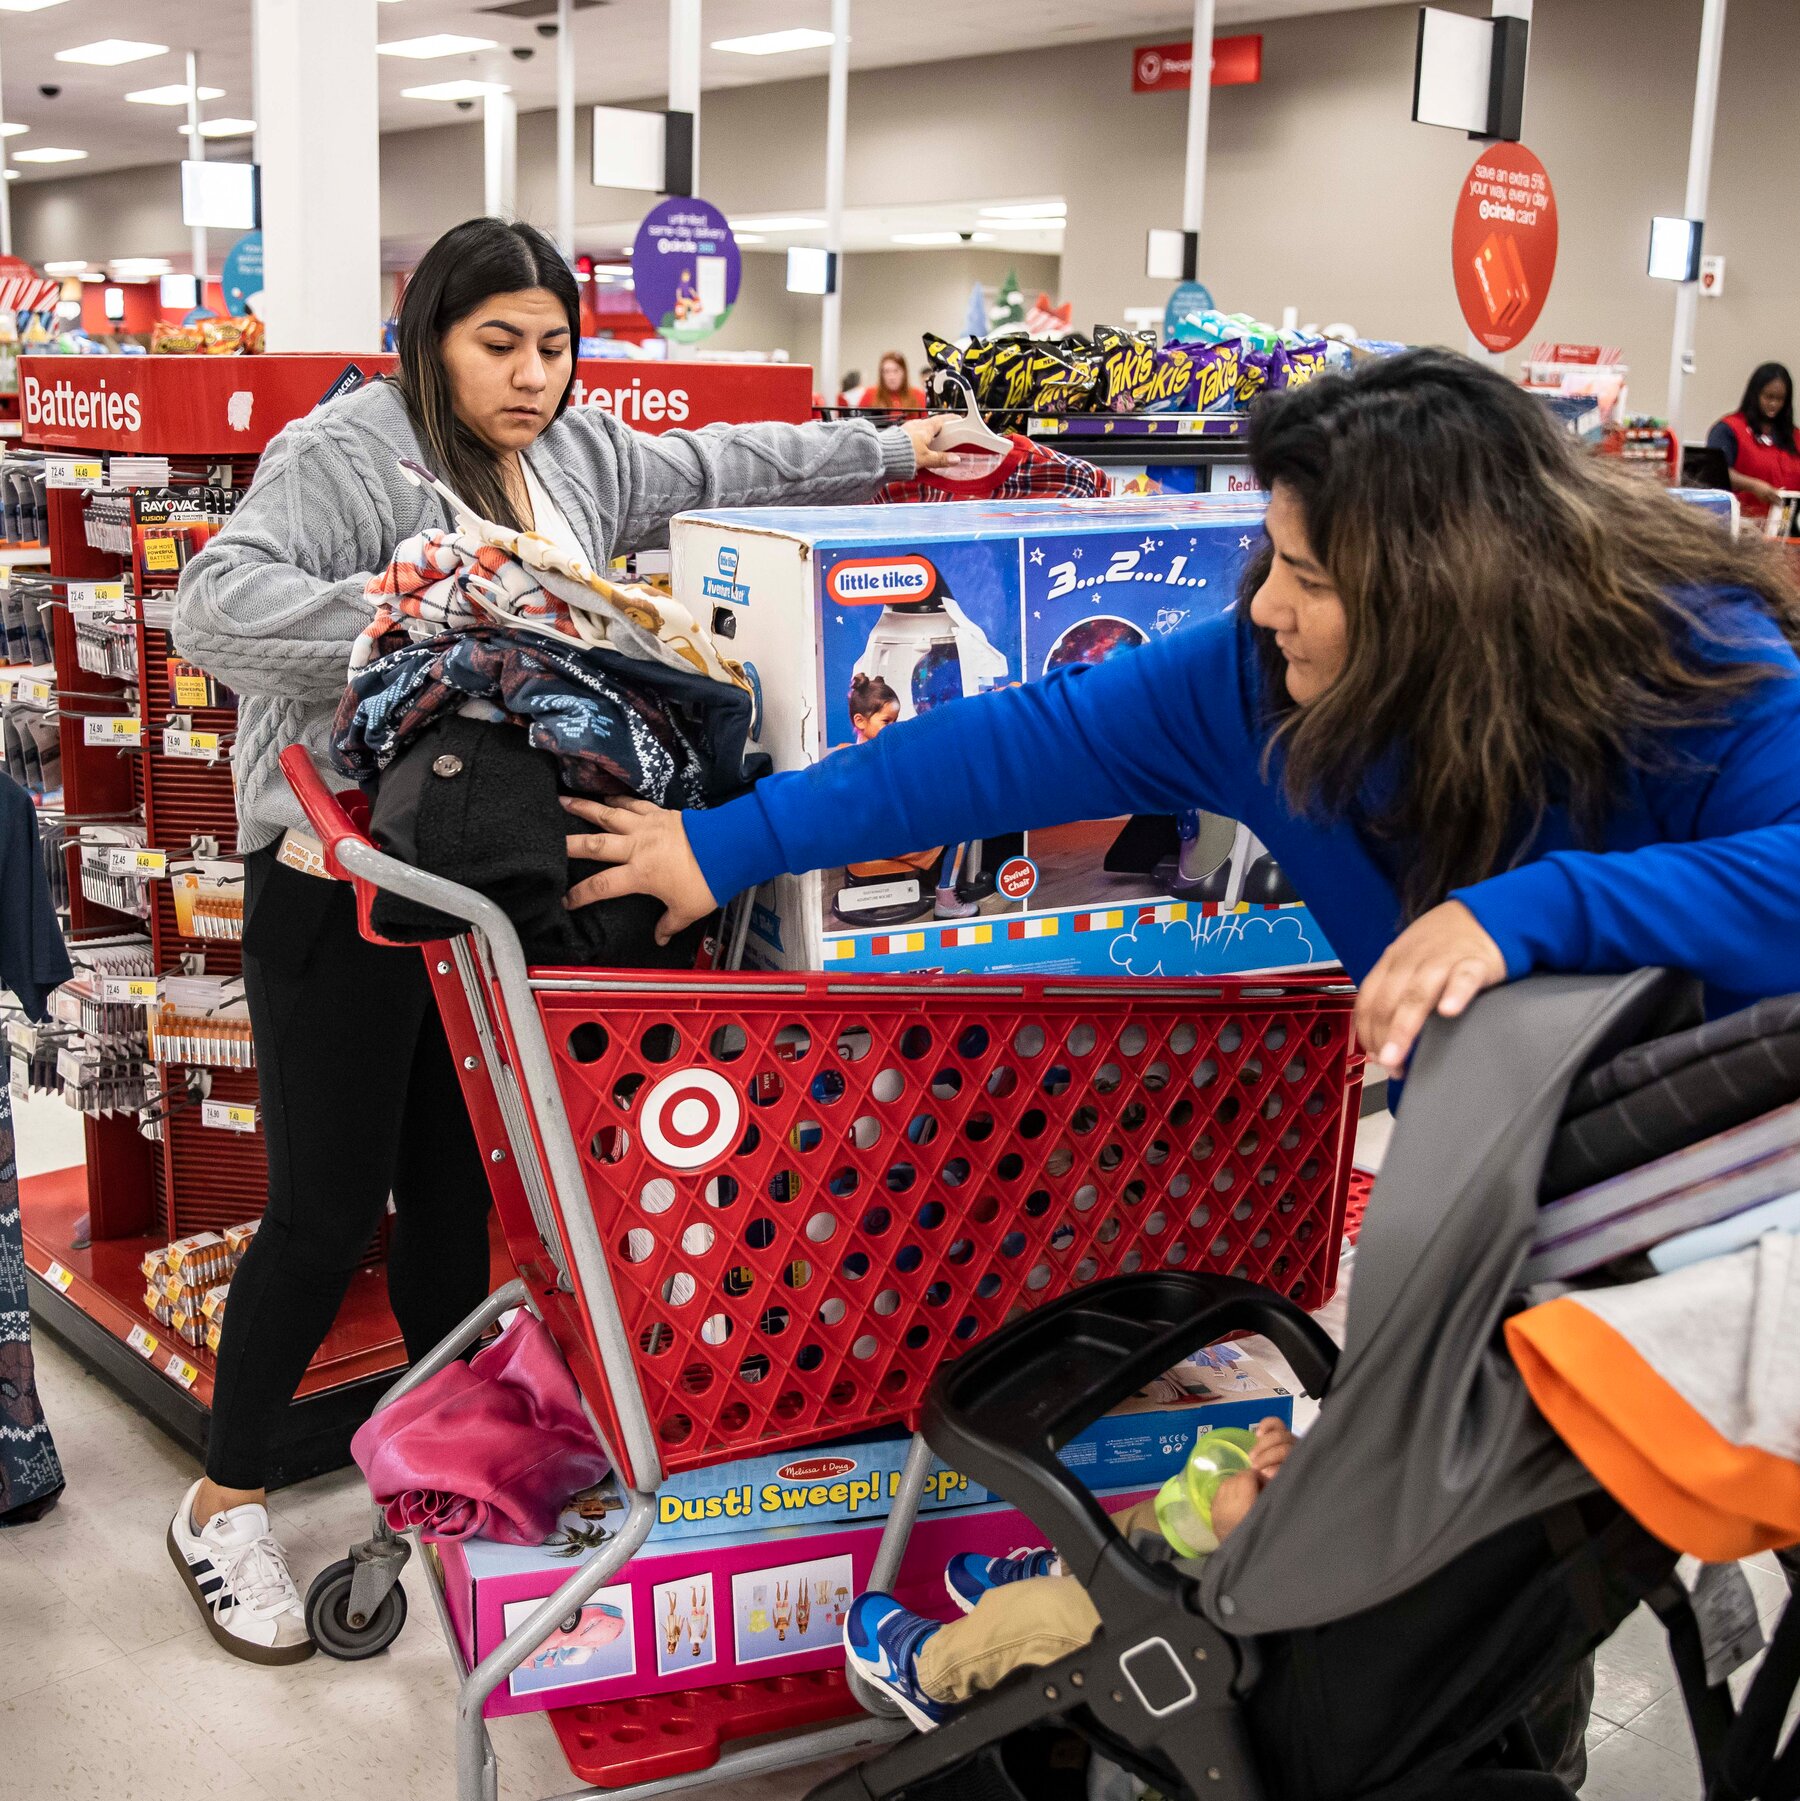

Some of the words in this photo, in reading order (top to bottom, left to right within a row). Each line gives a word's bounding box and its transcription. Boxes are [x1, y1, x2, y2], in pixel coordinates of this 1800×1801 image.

[1475, 164, 1495, 181] save
[1496, 169, 1508, 182] an
[1509, 171, 1529, 188] extra
[1531, 173, 1546, 191] 5%
[1469, 180, 1488, 197] your
[1508, 188, 1531, 207] every
[1532, 191, 1549, 211] day
[24, 376, 142, 432] Batteries
[571, 378, 690, 422] teries
[1228, 475, 1250, 491] Red
[141, 499, 200, 513] RAYOVAC
[840, 573, 879, 591] little
[882, 572, 923, 588] tikes
[1003, 866, 1030, 883] Swivel
[1007, 878, 1030, 892] Chair
[785, 1463, 819, 1478] Melissa
[829, 1463, 850, 1474] Doug
[659, 1485, 752, 1524] Dust!
[761, 1471, 881, 1512] Sweep!
